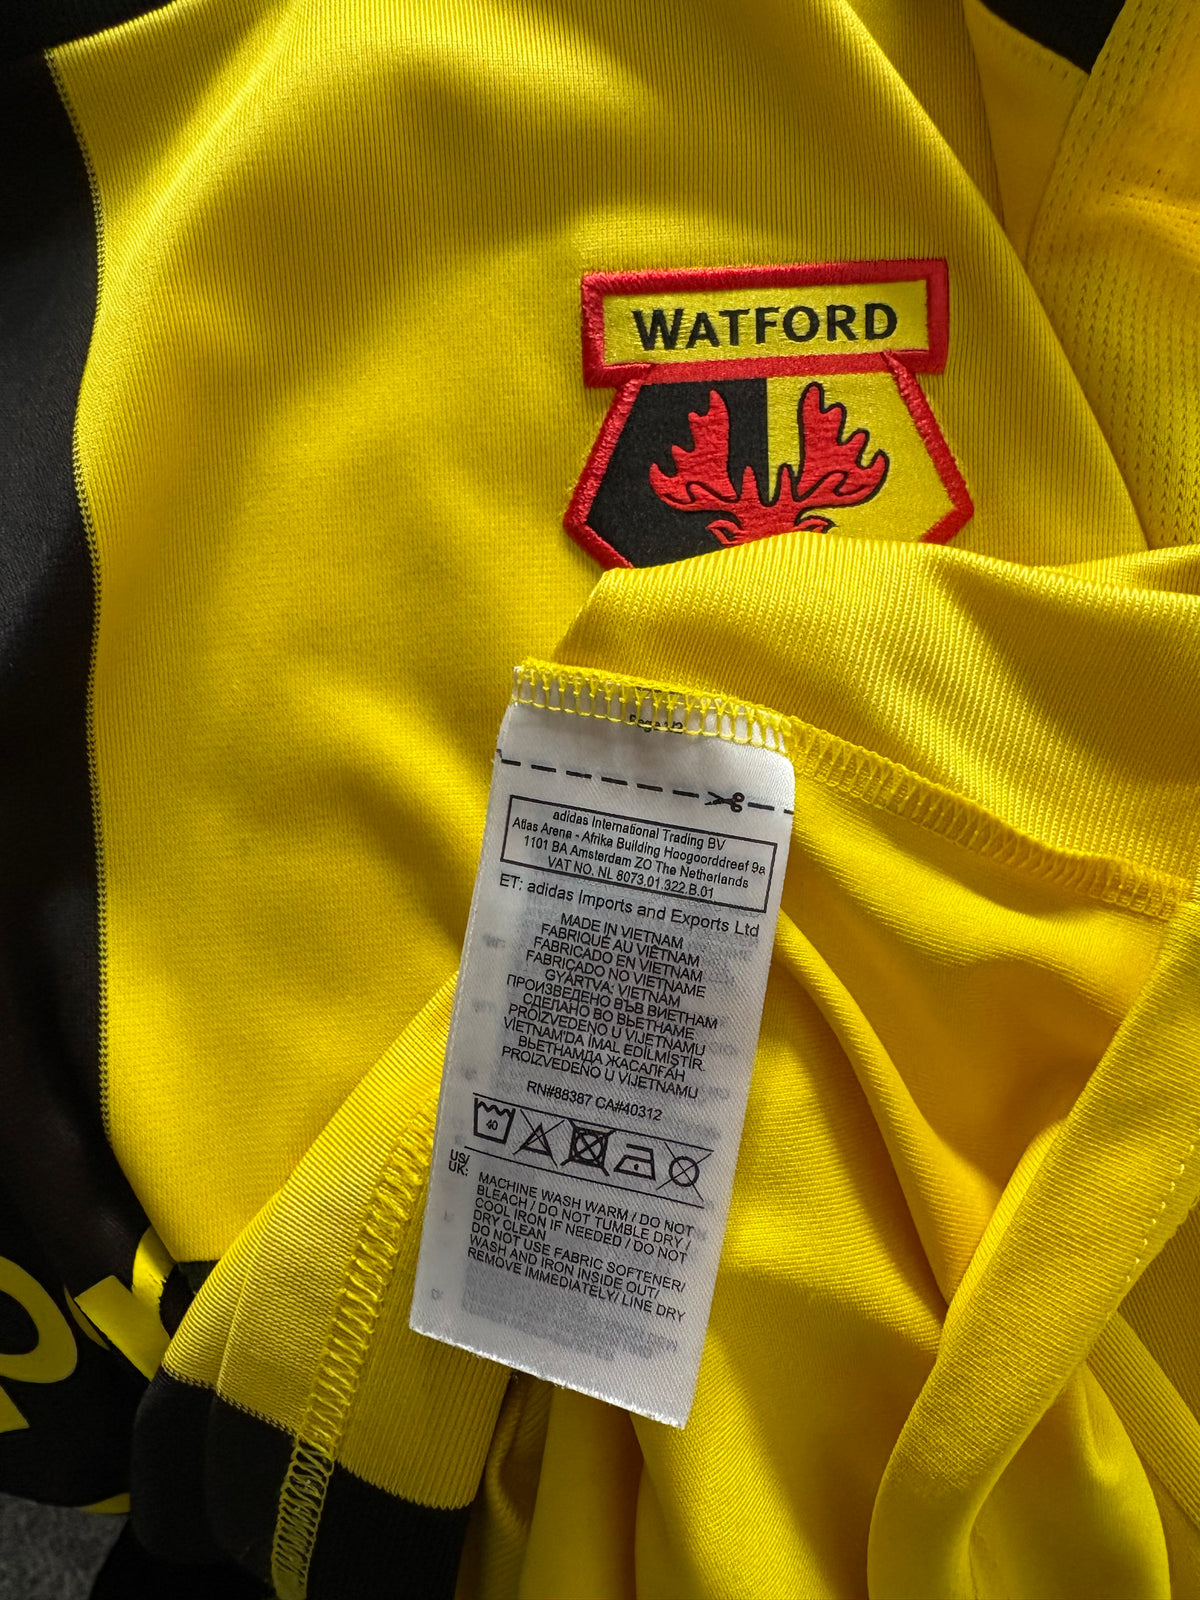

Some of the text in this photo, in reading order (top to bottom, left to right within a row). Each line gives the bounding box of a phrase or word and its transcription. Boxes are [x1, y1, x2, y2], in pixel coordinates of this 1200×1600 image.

[631, 302, 898, 351] WATFORD
[511, 816, 538, 832] Atlas
[540, 822, 572, 839] Arena
[580, 830, 613, 847] Afrika
[616, 836, 661, 859] Building
[663, 845, 750, 872] Hoogoorddreef
[751, 861, 765, 875] 9a
[552, 810, 726, 851] adidas International Trading BV
[524, 834, 749, 889] 1101 BA Amsterdam ZO The Netherlands
[548, 855, 572, 871] VAT
[573, 860, 594, 876] NO.
[597, 865, 613, 880] NL
[499, 872, 760, 937] ET: adidas Imports and Exports Ltd
[560, 912, 684, 949] MADE IN VIETNAM
[612, 939, 633, 954] AU
[525, 949, 706, 998] FABRICADO NO VIETNAME
[533, 935, 613, 964] FABRICADO
[615, 953, 636, 970] EN
[639, 957, 703, 983] VIETNAM
[506, 973, 718, 1030] ПРОИЗВЕДЕНО ВЪВ ВИЕТНАМ
[522, 992, 695, 1040] СДЕЛАНО ВО ВЬЕТНАМЕ
[508, 1002, 706, 1057] PROIZVEDENO U VIJETNAMU
[517, 1035, 603, 1065] ВЬЕТНАМДА
[501, 1045, 699, 1100] PROIZVEDENO U VIJETNAMU
[526, 1079, 663, 1121] RN#88387 CA#40312
[448, 1148, 470, 1167] US/
[448, 1159, 469, 1177] UK:
[473, 1208, 547, 1241] DRY CLEAN
[476, 1184, 528, 1209] BLEACH
[537, 1202, 558, 1217] DO
[561, 1208, 591, 1225] NOT
[594, 1215, 650, 1241] TUMBLE
[652, 1230, 683, 1248] DRY
[478, 1171, 538, 1198] MACHINE
[541, 1188, 581, 1210] WASH
[585, 1199, 629, 1222] WARM
[638, 1213, 661, 1229] DO
[663, 1219, 695, 1237] NOT
[475, 1197, 510, 1218] COOL
[513, 1208, 547, 1228] IRON
[549, 1218, 563, 1231] IF
[565, 1222, 622, 1248] NEEDED
[633, 1239, 655, 1255] DO
[657, 1245, 688, 1264] NOT
[470, 1233, 660, 1299] WASH AND IRON INSIDE OUT/
[471, 1221, 686, 1293] DO NOT USE FABRIC SOFTENER/
[467, 1246, 686, 1323] REMOVE IMMEDIATELY/ LINE DRY
